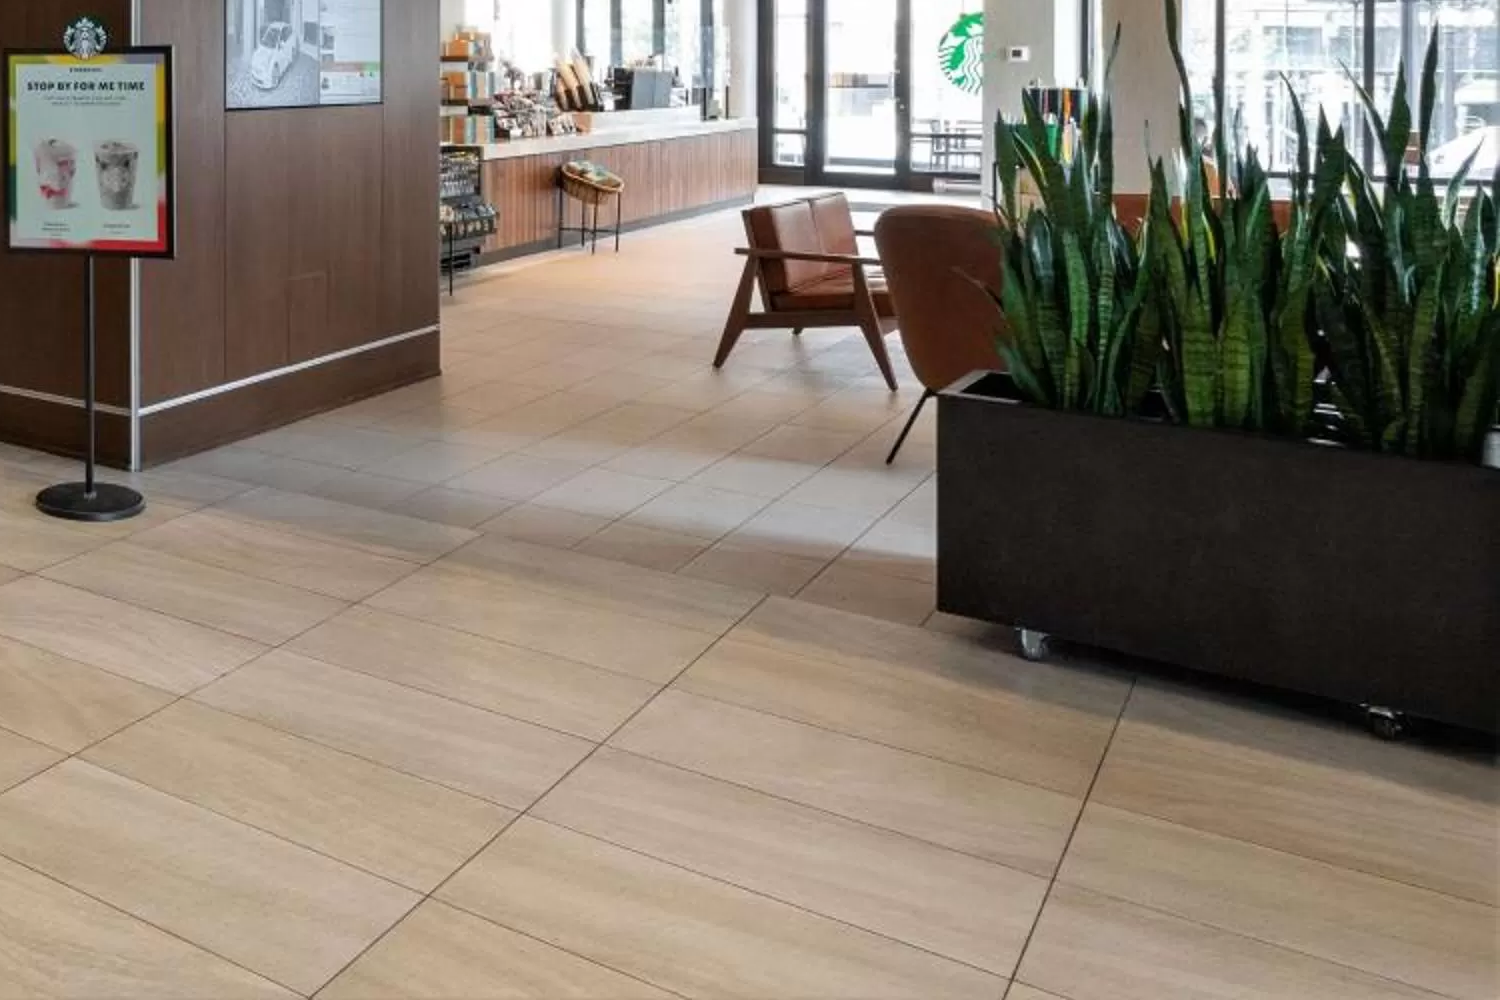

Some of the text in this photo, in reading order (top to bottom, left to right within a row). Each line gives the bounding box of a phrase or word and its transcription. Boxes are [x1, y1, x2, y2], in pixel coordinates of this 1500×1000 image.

[27, 81, 145, 91] STOP BY FOR ME TIME
